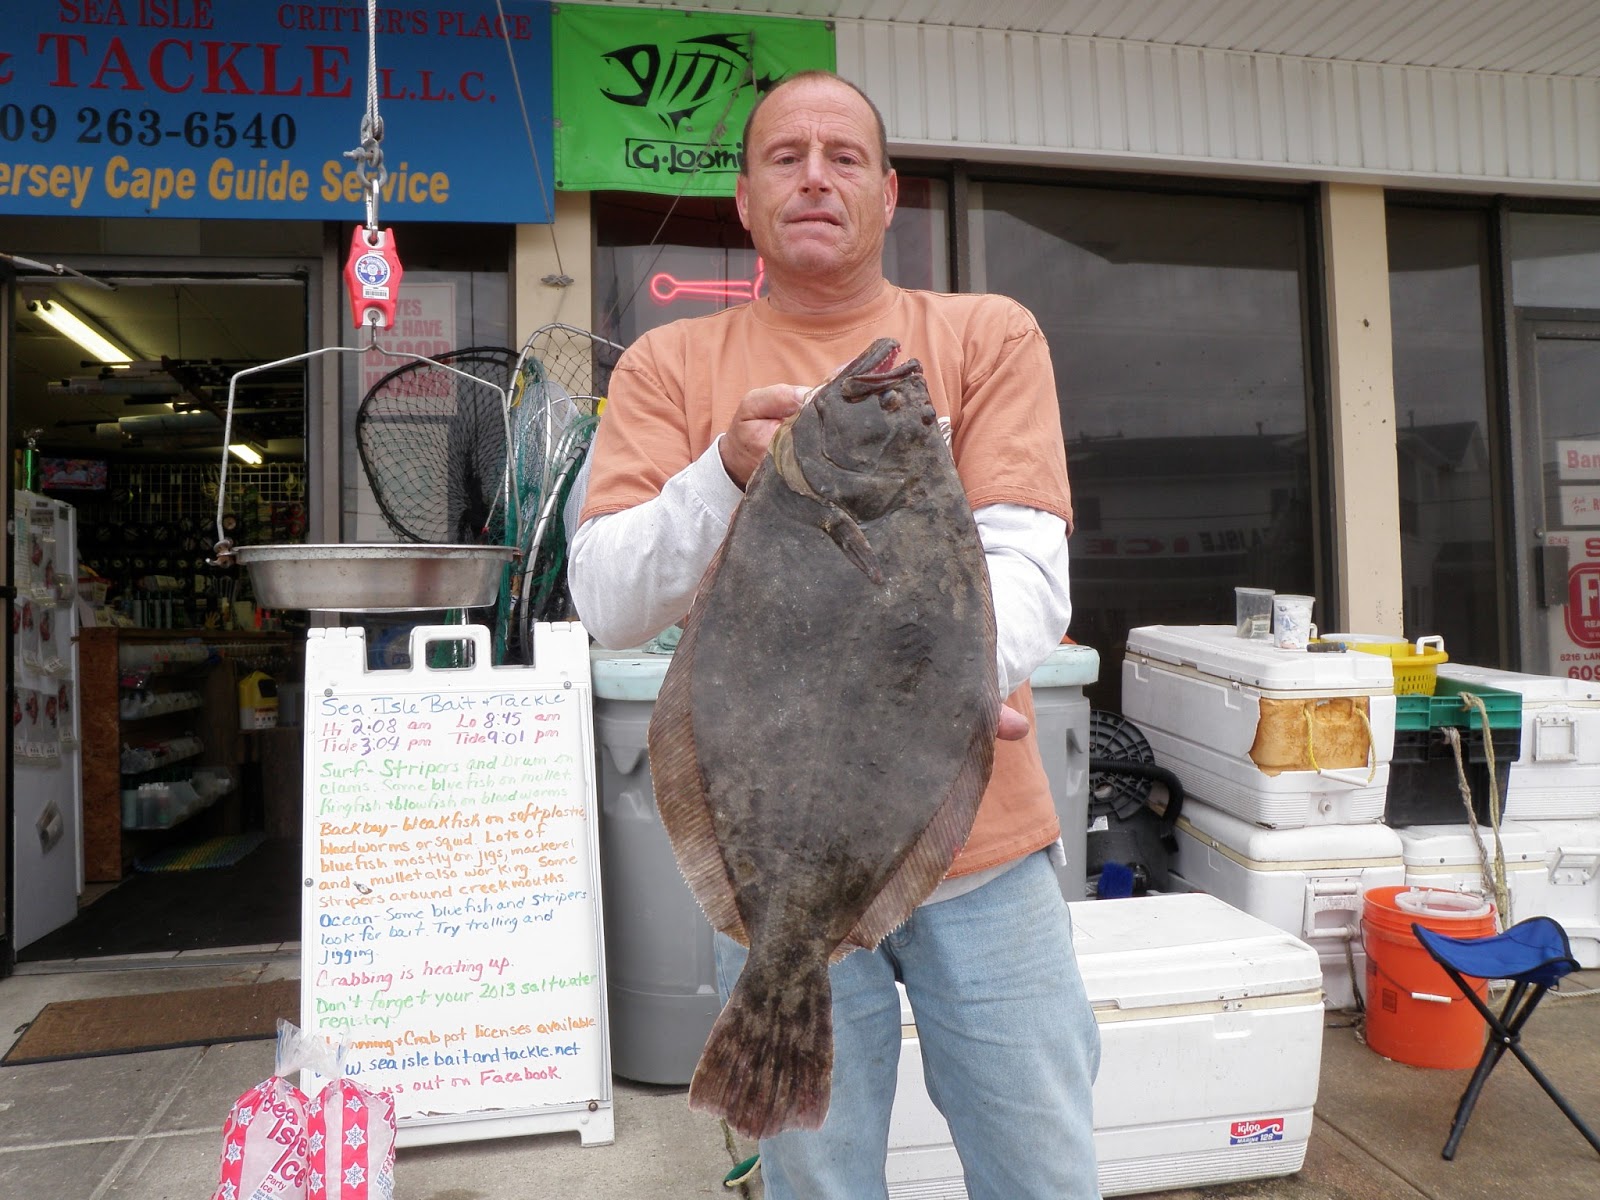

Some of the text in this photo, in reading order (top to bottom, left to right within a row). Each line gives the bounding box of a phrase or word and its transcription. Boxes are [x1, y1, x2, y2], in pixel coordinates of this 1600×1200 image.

[60, 0, 214, 30] SEA ISLE
[277, 4, 533, 40] CRITTER'S PLACE
[37, 33, 352, 98] TACKLE
[377, 68, 496, 103] L.L.C.
[77, 107, 297, 149] 263-6540
[105, 156, 197, 209] Cape
[208, 157, 309, 201] Guide
[402, 320, 443, 337] HAVE
[321, 698, 364, 716] Sea
[371, 697, 419, 714] Isle
[421, 694, 476, 712] Bait
[323, 712, 561, 736] Hi 2:08 am Lo 8:45 am
[318, 730, 559, 756] Tide 3:04 pm Tide 9:01 pm
[466, 755, 498, 770] and
[460, 797, 476, 806] on
[485, 815, 505, 825] on
[416, 841, 433, 850] or
[486, 830, 519, 843] Lots
[524, 823, 548, 838] of
[394, 851, 452, 869] mostly
[454, 853, 474, 862] on
[511, 838, 575, 856] mackerel
[319, 876, 351, 890] and
[370, 869, 422, 886] mullet
[425, 868, 457, 879] also
[538, 856, 578, 868] Some
[390, 886, 452, 901] around
[459, 880, 510, 894] creek
[384, 907, 424, 921] Some
[497, 897, 526, 910] and
[321, 933, 355, 945] look
[359, 925, 381, 941] for
[432, 922, 460, 938] Try
[465, 916, 518, 933] trolling
[523, 909, 554, 923] and
[316, 969, 393, 992] Crabbing
[400, 965, 414, 980] is
[422, 959, 483, 981] heating
[316, 994, 363, 1014] Don't
[368, 989, 432, 1019] forget
[435, 992, 474, 1008] your
[479, 982, 516, 998] 2013
[444, 1027, 468, 1048] pot
[475, 1024, 531, 1038] licenses
[537, 1016, 596, 1035] available
[413, 1074, 445, 1091] out
[451, 1077, 471, 1088] on
[480, 1066, 562, 1086] Facebook
[267, 1118, 307, 1157] Isle
[271, 1147, 306, 1188] Ice
[260, 1181, 273, 1193] Ice
[266, 1173, 287, 1192] Party
